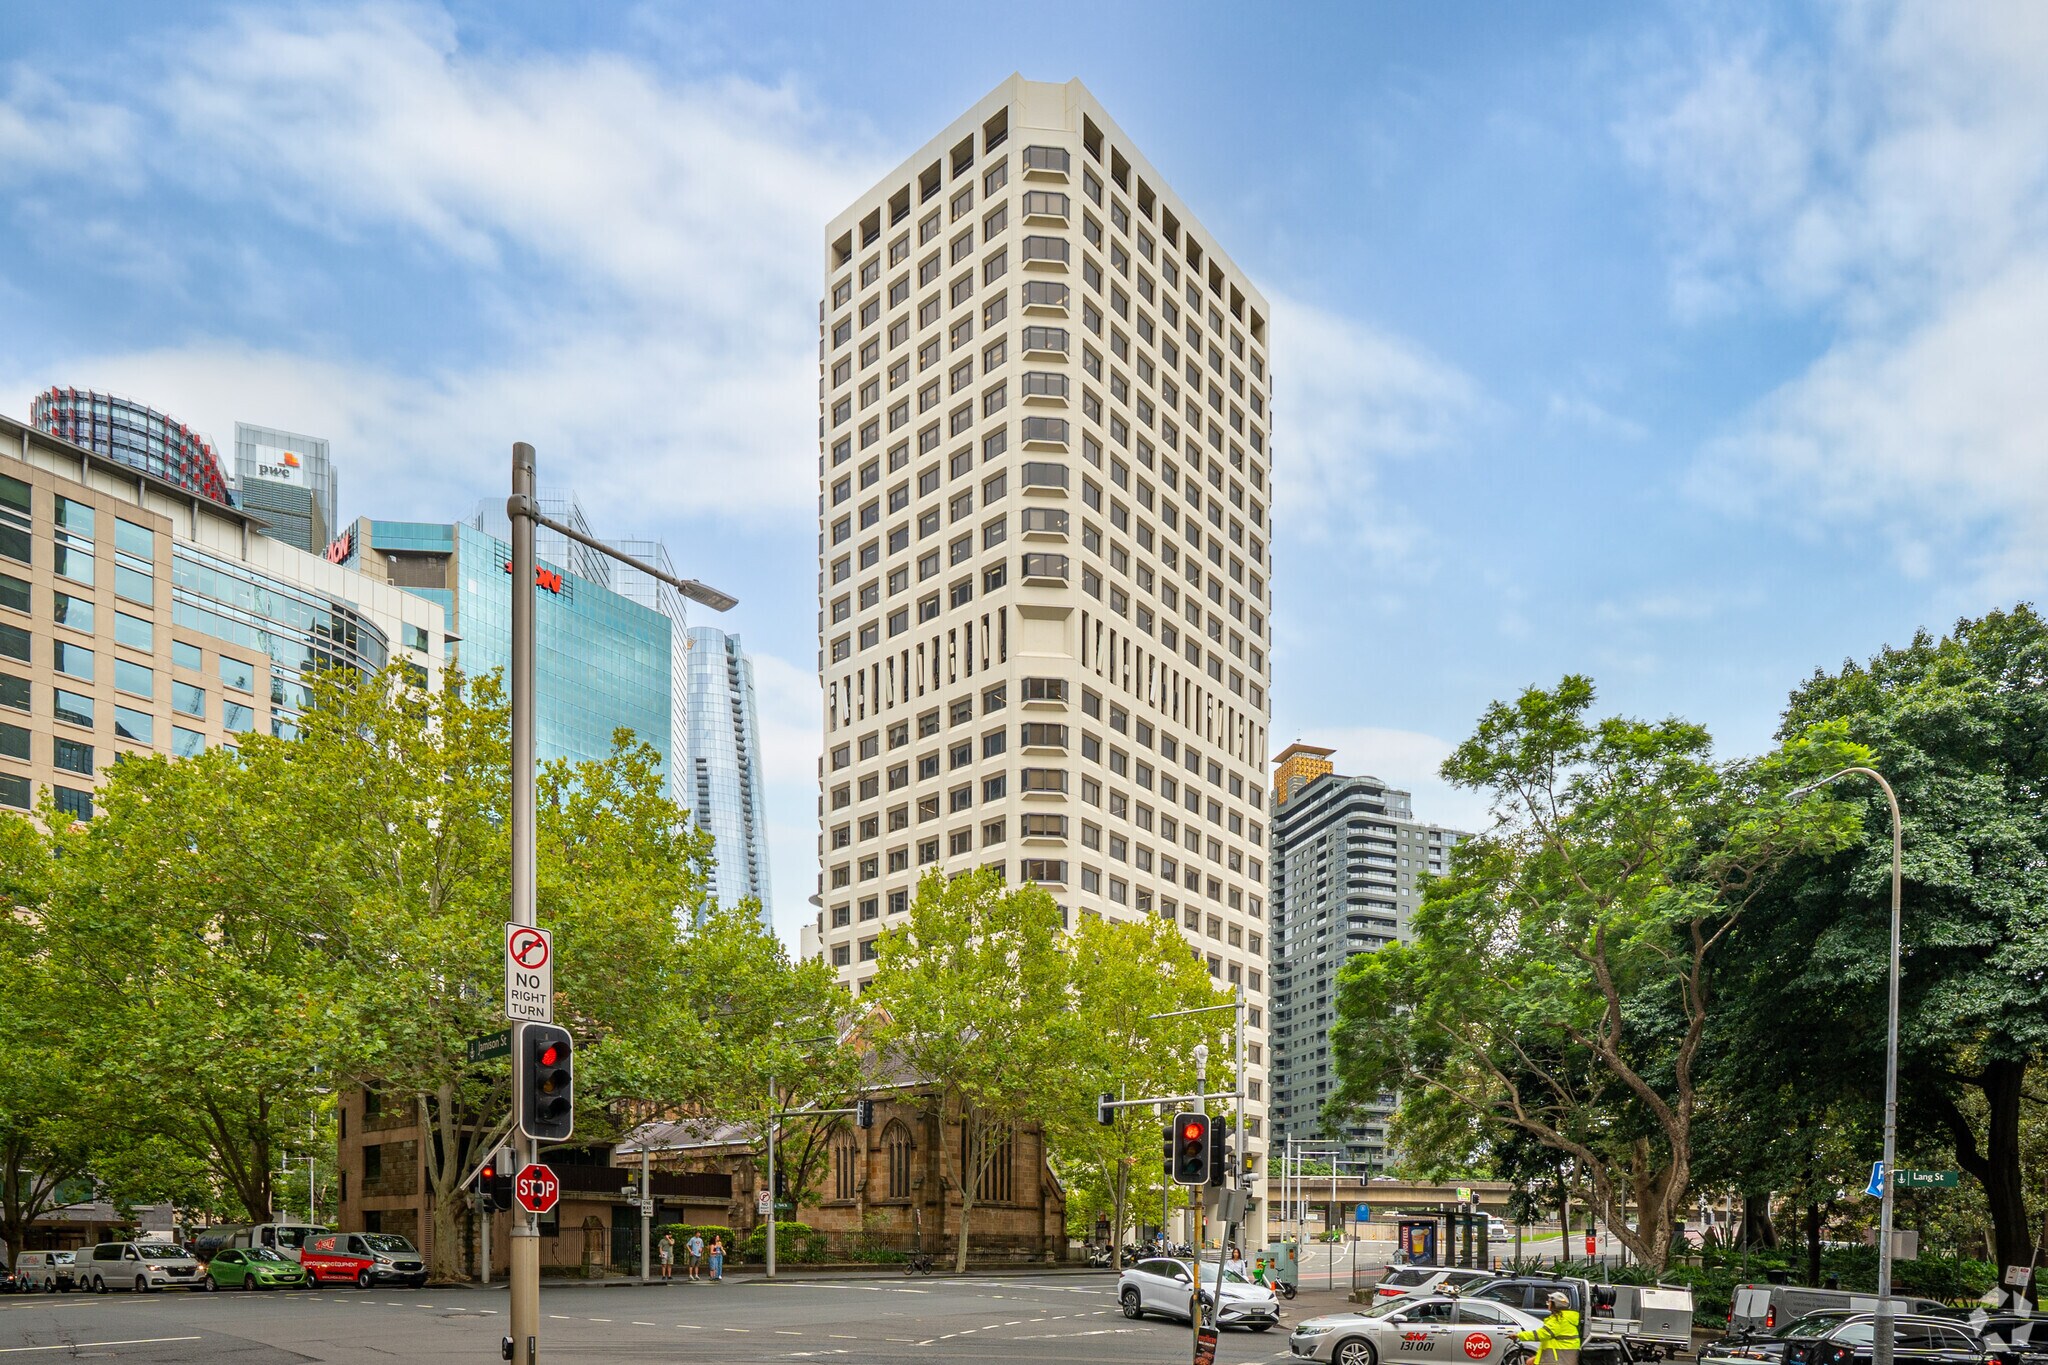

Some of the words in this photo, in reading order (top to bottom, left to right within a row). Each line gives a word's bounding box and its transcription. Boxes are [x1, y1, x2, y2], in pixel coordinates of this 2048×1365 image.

[258, 464, 290, 478] pwc
[327, 533, 351, 563] AON
[516, 972, 540, 989] NO
[511, 990, 546, 1004] RIGHT
[512, 1003, 544, 1017] TURN
[477, 1039, 500, 1056] Jamison
[500, 1034, 507, 1047] St
[1913, 1172, 1933, 1183] Lang
[1934, 1172, 1944, 1181] St
[520, 1178, 555, 1198] STOP
[1400, 1341, 1415, 1351] 131
[1416, 1341, 1435, 1352] 001
[1466, 1341, 1491, 1352] Rydo
